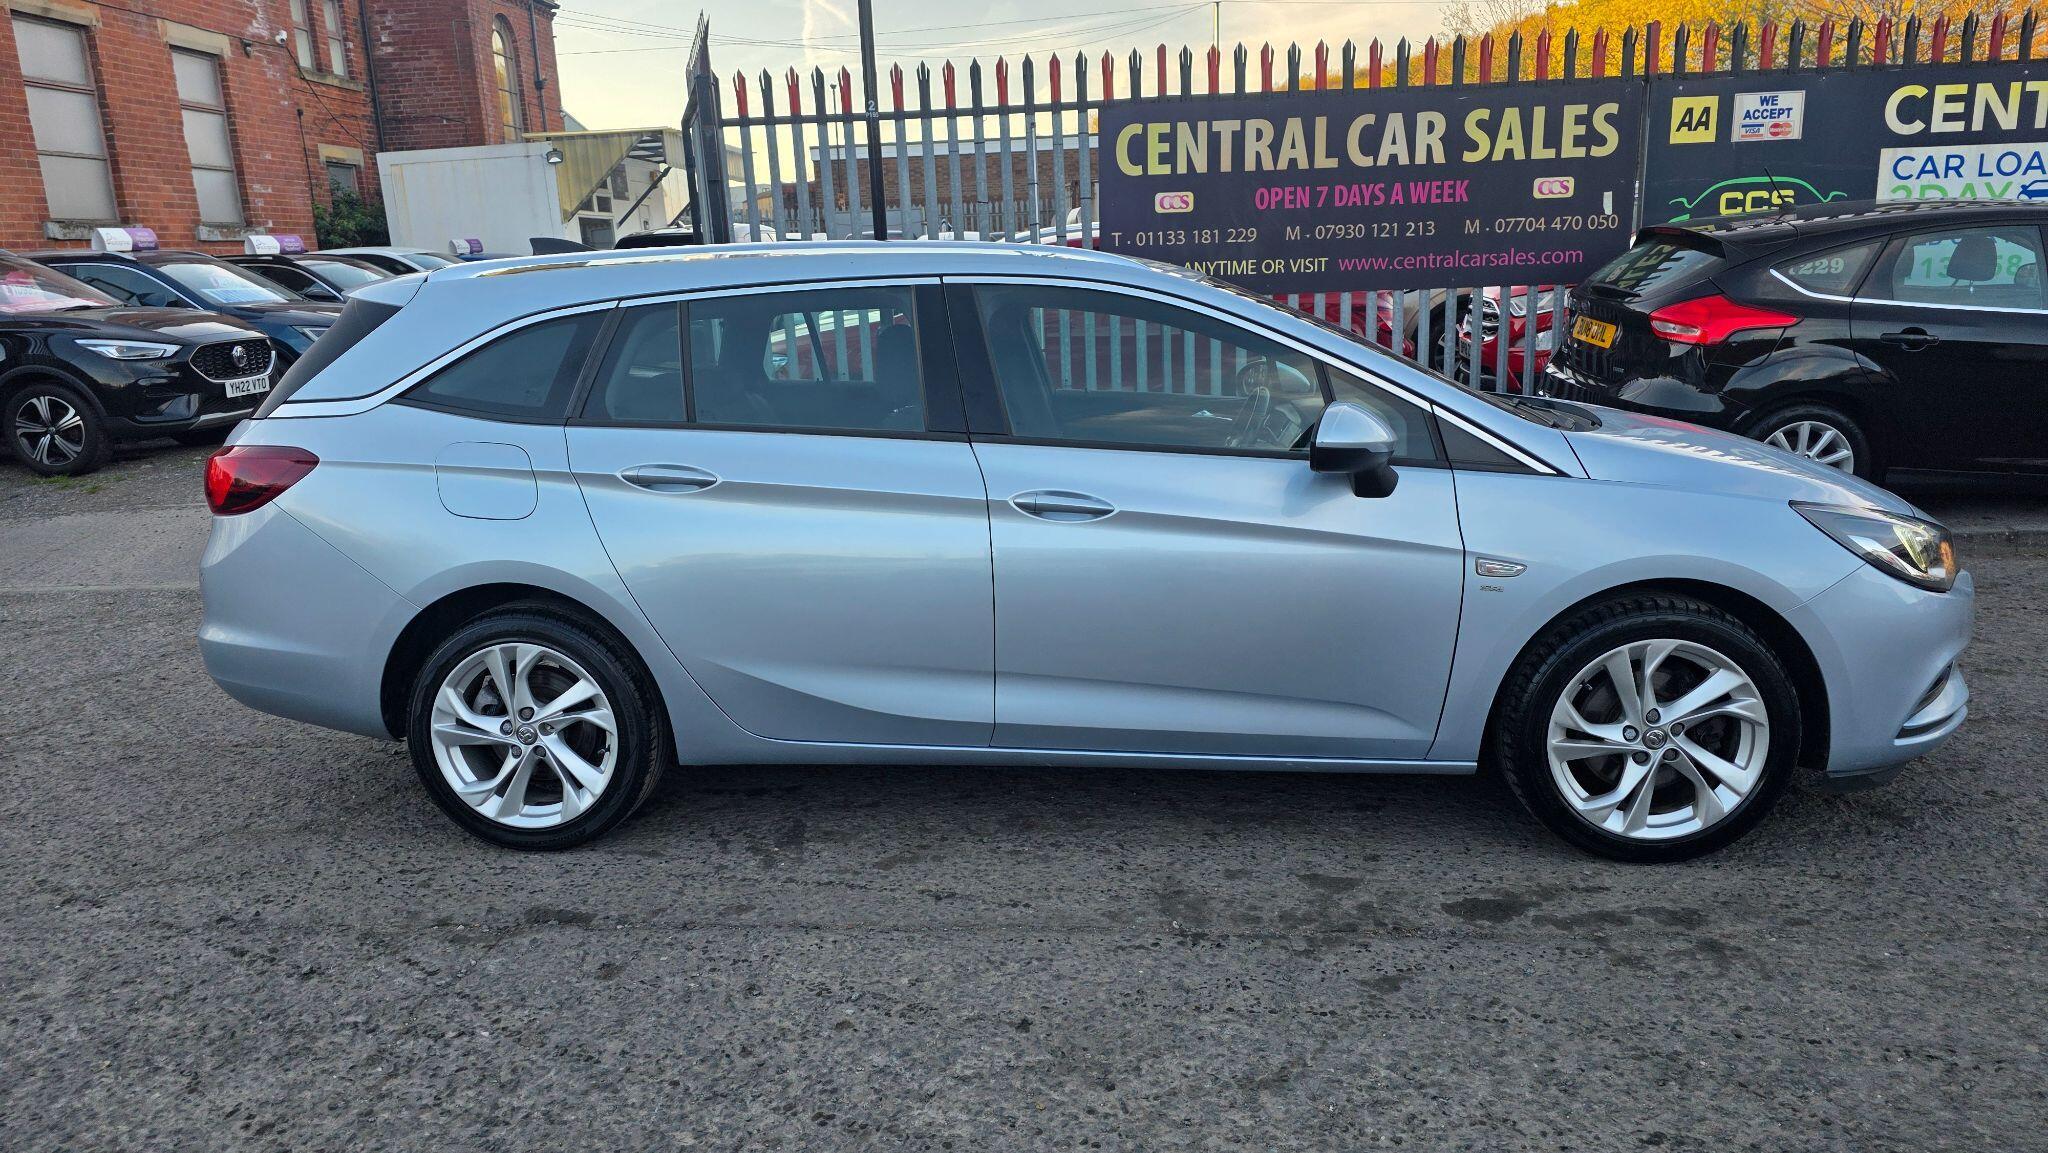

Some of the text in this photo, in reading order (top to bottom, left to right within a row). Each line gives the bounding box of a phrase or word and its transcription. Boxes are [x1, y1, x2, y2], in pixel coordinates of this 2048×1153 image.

[868, 100, 876, 111] 2
[1760, 95, 1779, 107] WE
[1884, 80, 2048, 135] CENT
[1675, 106, 1711, 132] AA
[1742, 107, 1793, 120] ACCEPT
[1115, 102, 1620, 176] CENTRAL CAR SALES
[1892, 150, 2047, 181] CAR LOA
[1255, 179, 1470, 209] OPEN 7 DAYS A WEEK
[1537, 179, 1570, 196] CCS
[1159, 194, 1190, 210] CCS
[1720, 189, 1795, 215] CCS
[1315, 223, 1365, 240] 07930
[1372, 223, 1398, 238] 121
[1405, 221, 1436, 237] 213
[1495, 216, 1546, 233] 07704
[1551, 215, 1582, 231] 470
[1587, 213, 1619, 230] 050
[1136, 230, 1186, 246] 01133
[1193, 228, 1220, 244] 181
[1227, 227, 1257, 243] 229
[1184, 247, 1583, 276] ANYTIME OR VISIT www.centralcarsales.com
[229, 380, 251, 394] YH22
